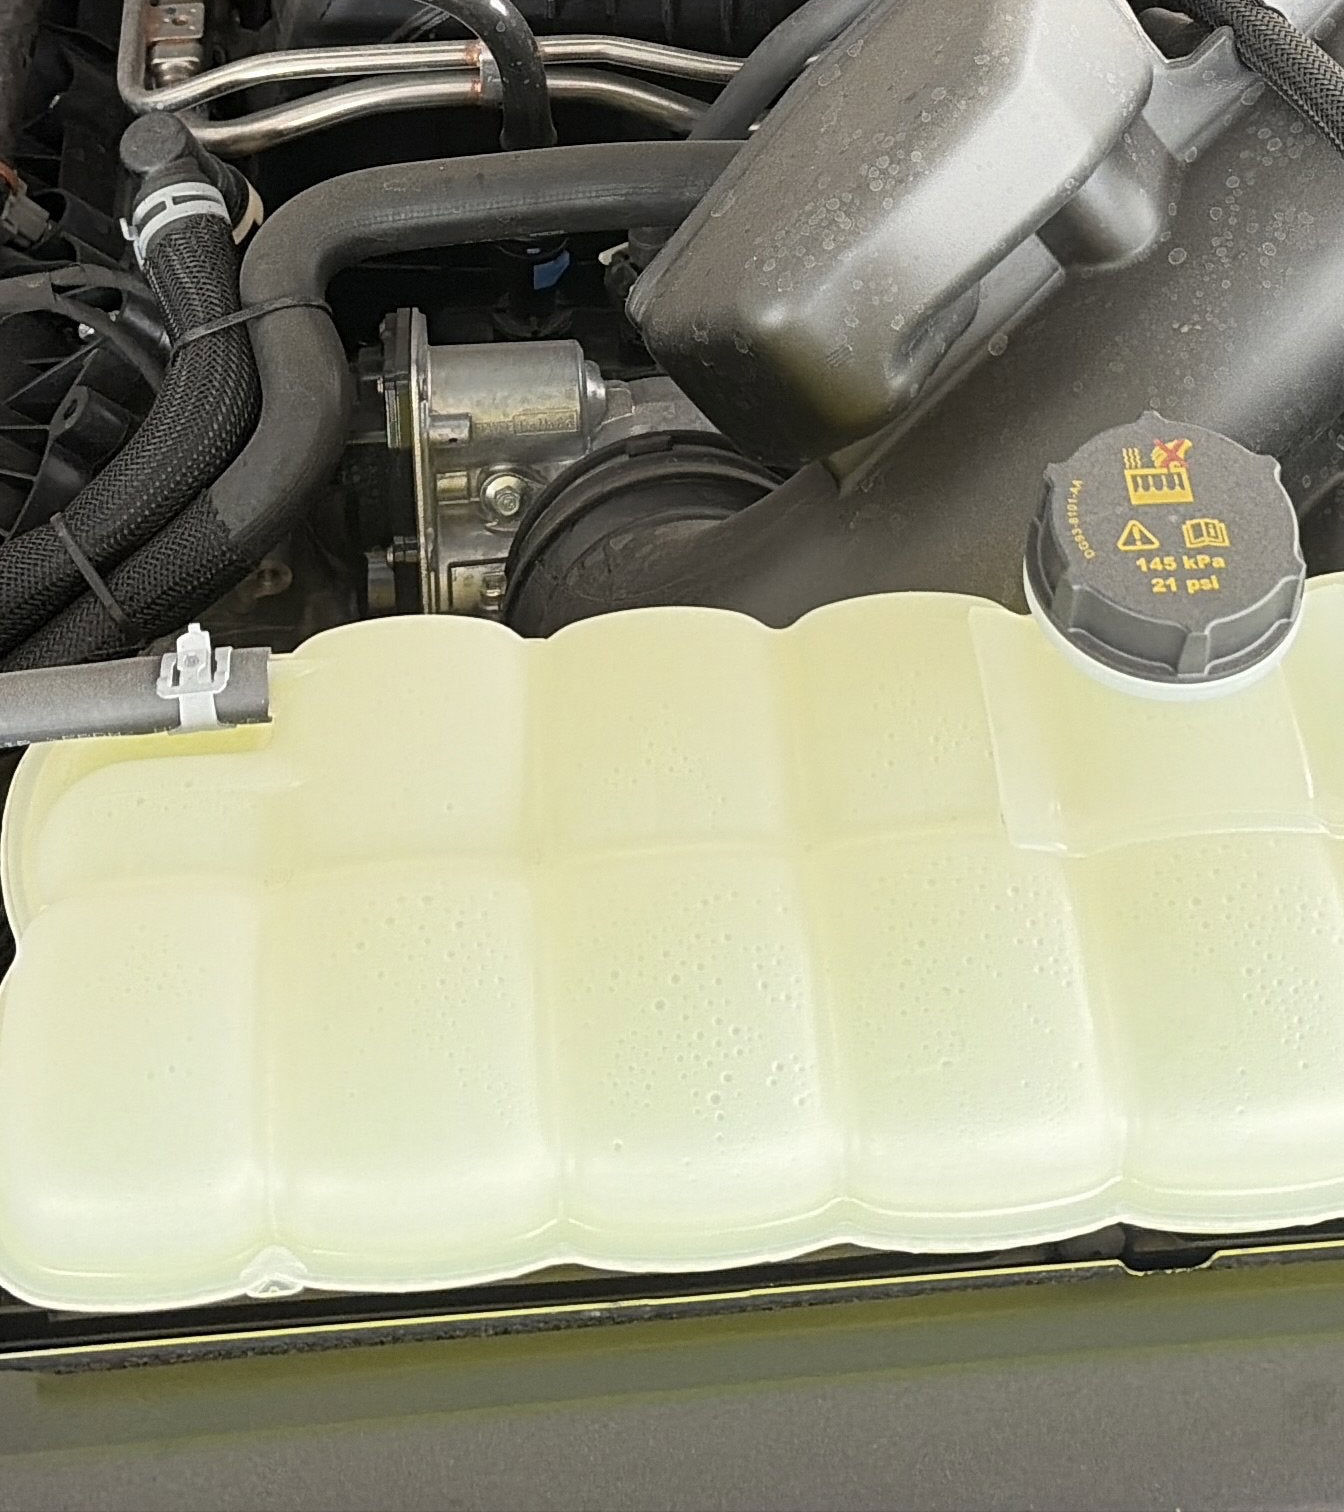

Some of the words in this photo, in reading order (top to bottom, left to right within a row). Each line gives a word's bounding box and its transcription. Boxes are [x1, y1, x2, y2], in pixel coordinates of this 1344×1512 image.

[1136, 555, 1178, 573] 145
[1183, 554, 1227, 571] kPa
[1151, 578, 1178, 594] 21
[1186, 574, 1221, 595] psi
